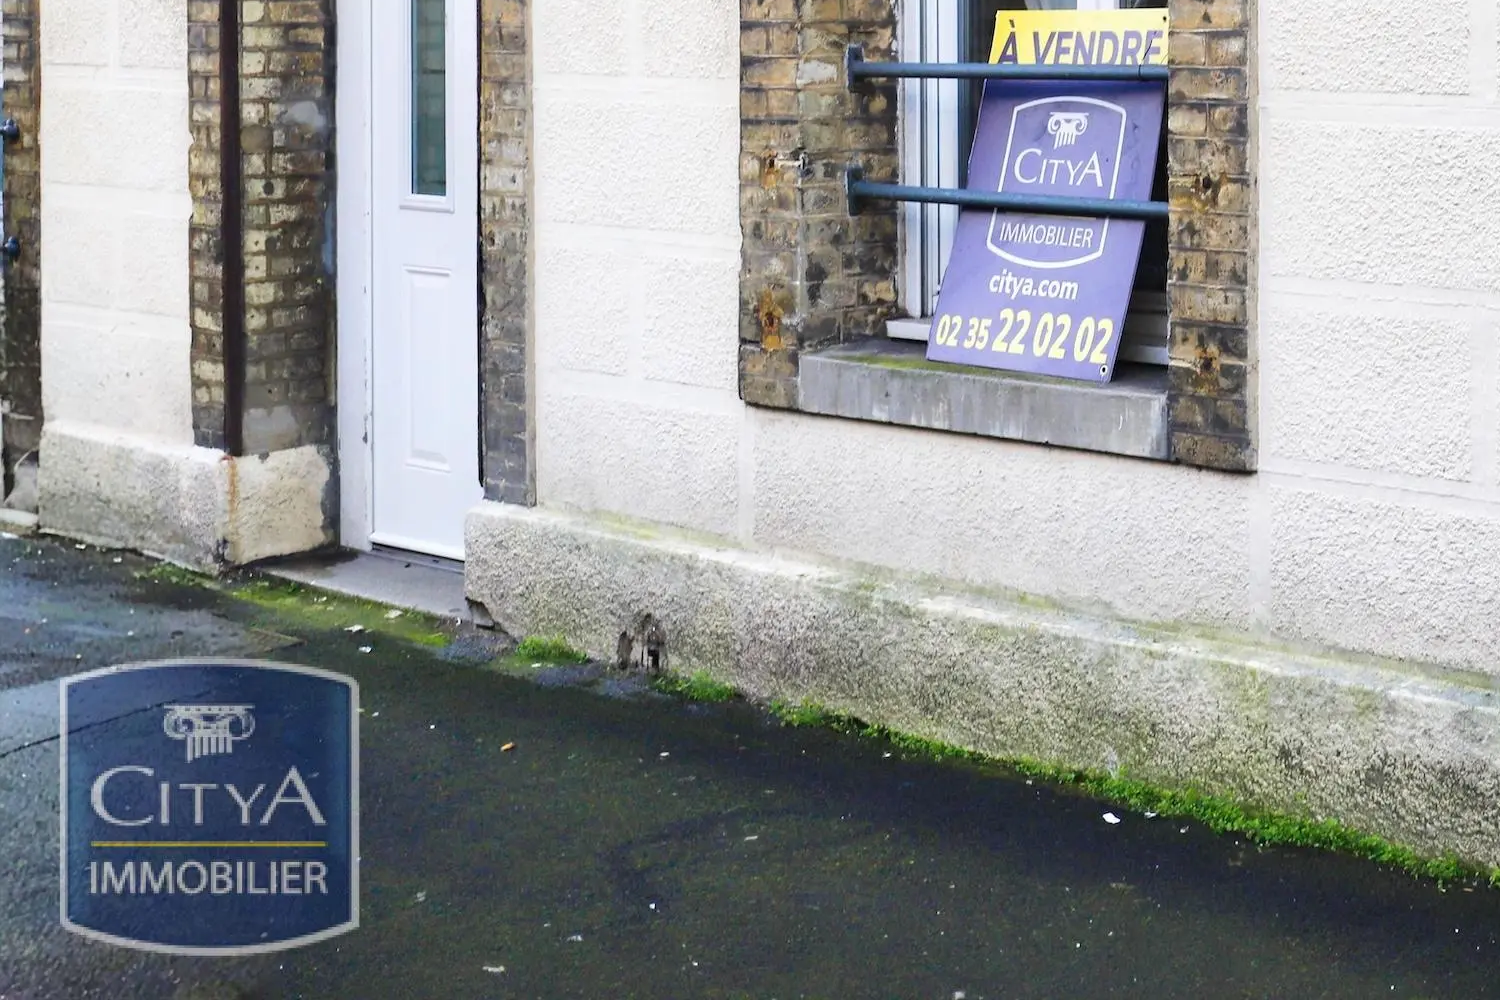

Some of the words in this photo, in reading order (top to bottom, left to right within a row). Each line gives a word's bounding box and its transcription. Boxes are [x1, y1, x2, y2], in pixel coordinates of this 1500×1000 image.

[998, 19, 1018, 64] À
[1033, 30, 1163, 64] VENDRE
[1000, 221, 1094, 248] IMMOBILIER
[989, 268, 1078, 301] citya.com
[936, 313, 962, 347] 02
[963, 317, 992, 351] 35
[992, 308, 1031, 355] 22
[1033, 312, 1072, 360] 02
[1073, 315, 1114, 364] 02
